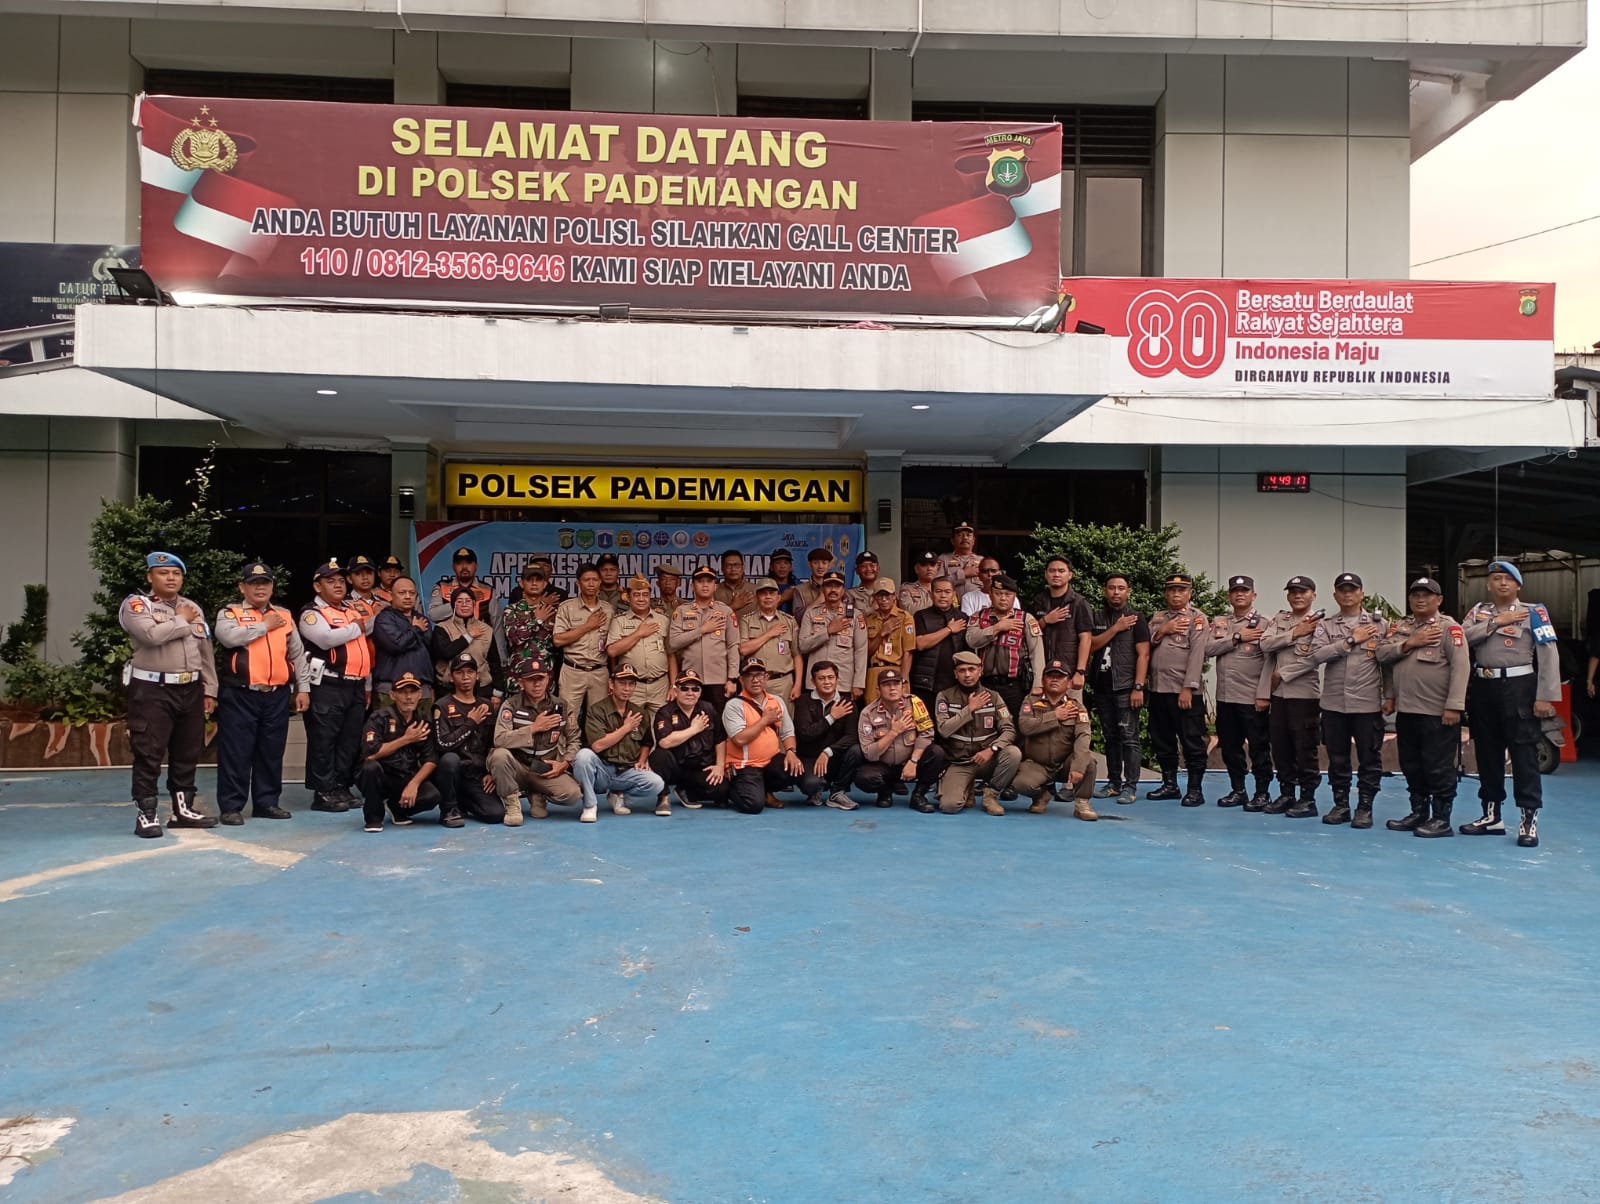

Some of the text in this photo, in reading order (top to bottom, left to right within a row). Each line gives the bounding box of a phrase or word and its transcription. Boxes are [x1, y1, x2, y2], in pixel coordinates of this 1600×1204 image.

[392, 117, 828, 168] SELAMAT DATANG
[986, 134, 1031, 145] METRO JAYA
[358, 166, 858, 210] DI POLSEK PADEMANGAN
[251, 208, 959, 254] ANDA BUTUH LAYANAN POLISI. SILAHKAN CALL CENTER
[300, 248, 348, 276] 110
[366, 249, 565, 281] 0812-3566-9646
[570, 256, 637, 284] KAMI
[643, 258, 702, 286] SIAP
[708, 260, 834, 289] MELAYANI
[840, 263, 911, 291] ANDA
[59, 282, 97, 295] CATUR
[1235, 289, 1414, 314] Bersatu Berdaulat
[1126, 289, 1229, 378] 80
[1235, 311, 1404, 338] Rakyat Sejahtera
[1235, 340, 1380, 364] Indonesia Maju
[1234, 369, 1451, 384] DIRGAHAYU REPUBLIK INDONESIA
[457, 473, 851, 503] POLSEK PADEMANGAN
[490, 552, 538, 575] APE
